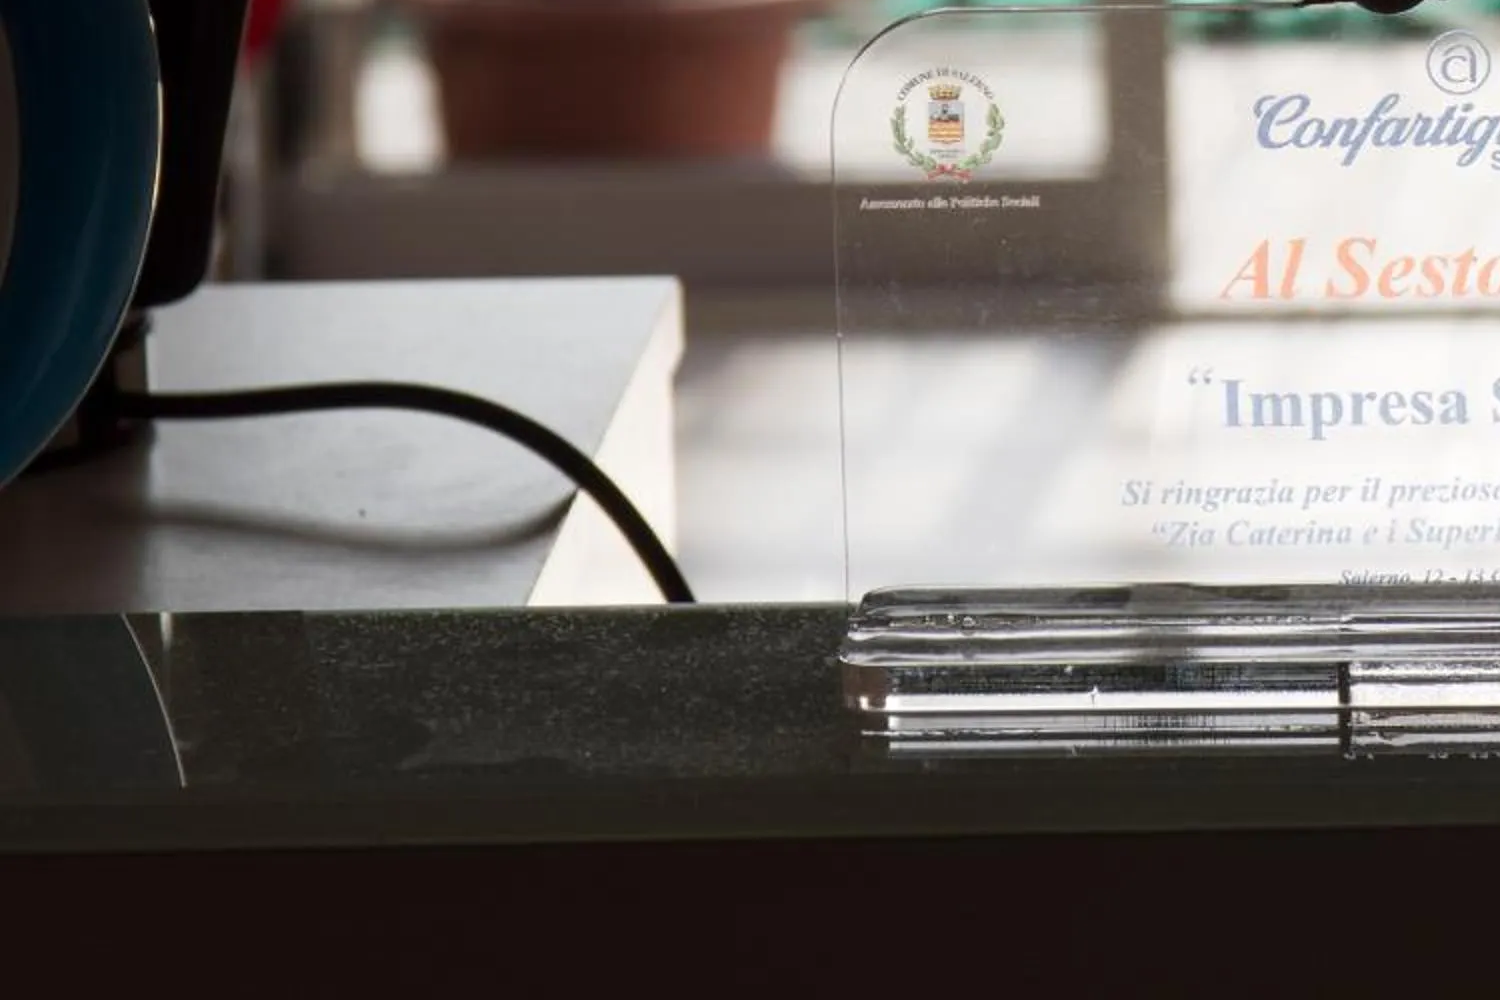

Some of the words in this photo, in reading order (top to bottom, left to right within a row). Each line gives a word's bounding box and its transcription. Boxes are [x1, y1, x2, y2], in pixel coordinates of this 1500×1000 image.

[1219, 237, 1306, 299] Al
[1121, 480, 1151, 506] Si
[1160, 478, 1294, 513] ringrazia
[1300, 484, 1353, 511] per
[1360, 477, 1382, 503] il
[1226, 519, 1353, 547] Caterina
[1361, 525, 1379, 545] e
[1387, 516, 1397, 544] i
[1423, 567, 1444, 584] 12
[1464, 567, 1485, 584] 13
